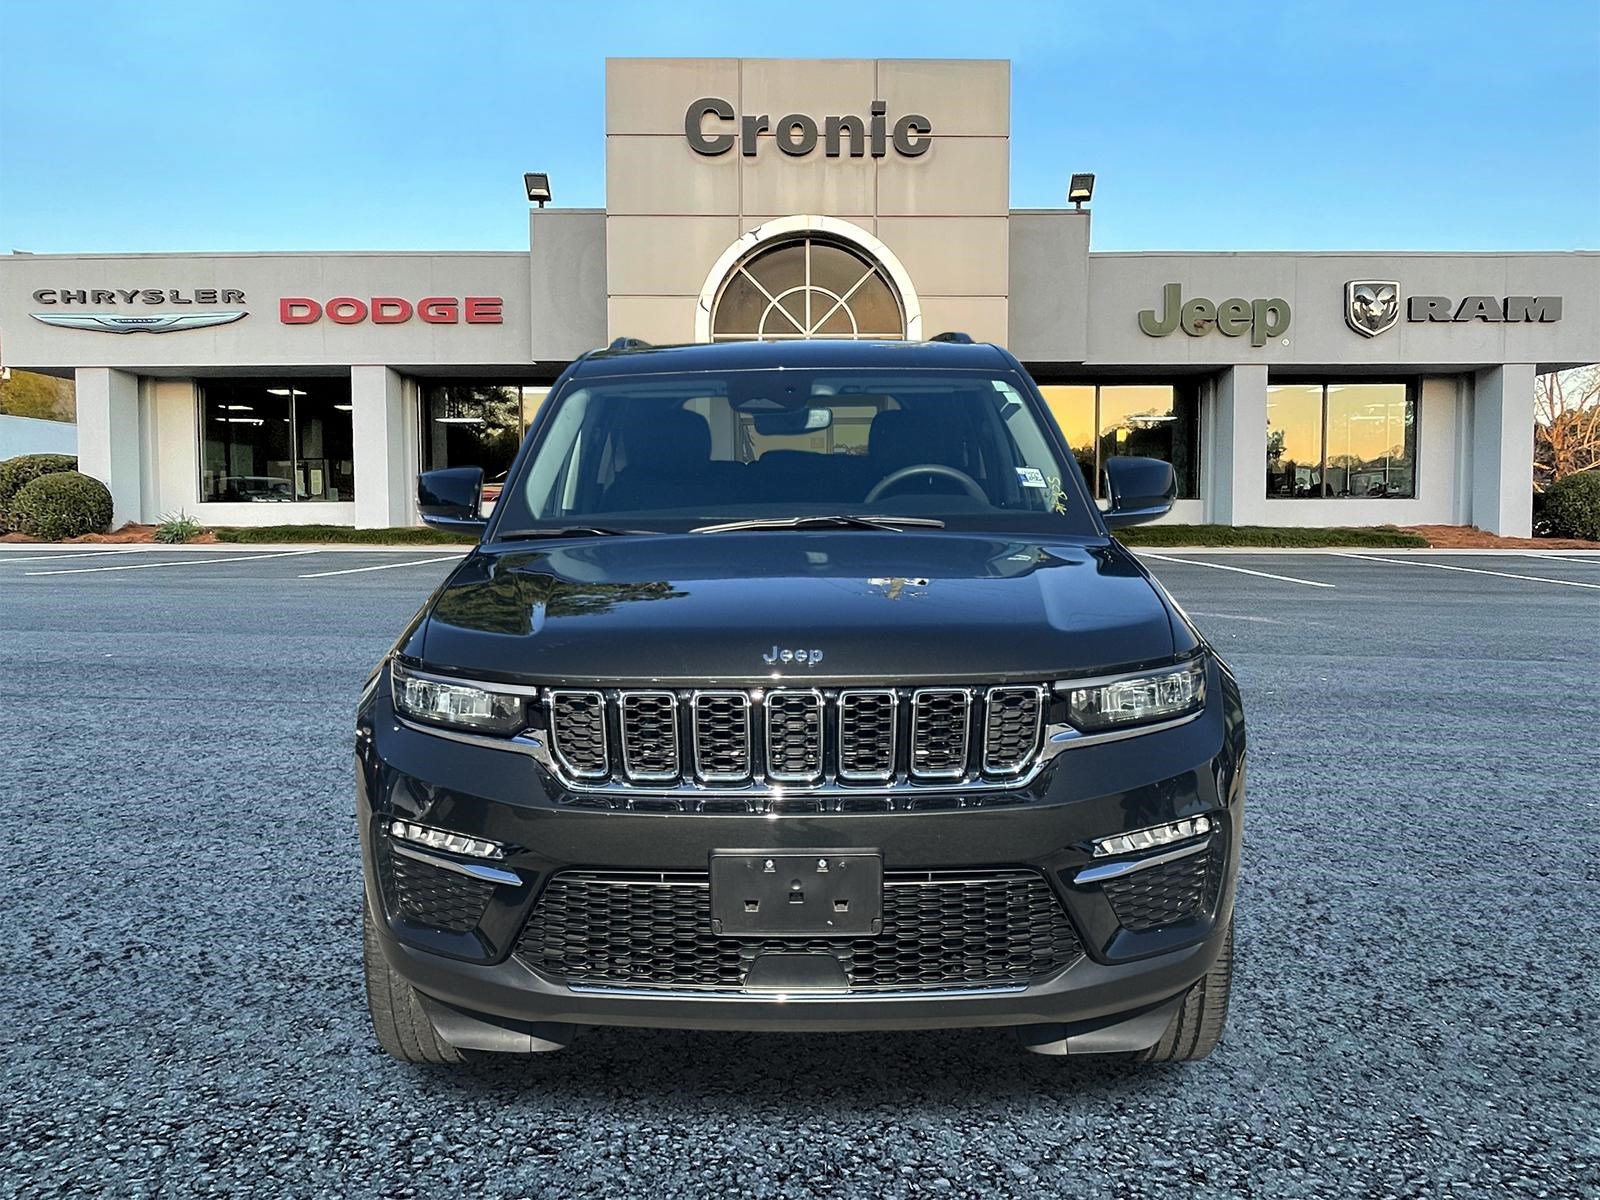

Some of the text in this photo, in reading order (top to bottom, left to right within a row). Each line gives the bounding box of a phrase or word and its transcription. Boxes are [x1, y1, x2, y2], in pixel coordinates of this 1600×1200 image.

[685, 98, 932, 157] Cronic
[32, 289, 247, 304] CHRYSLER
[1407, 296, 1563, 323] RAM
[279, 297, 503, 325] DODGE
[1138, 283, 1292, 347] Jeep
[763, 645, 823, 666] Jeep
